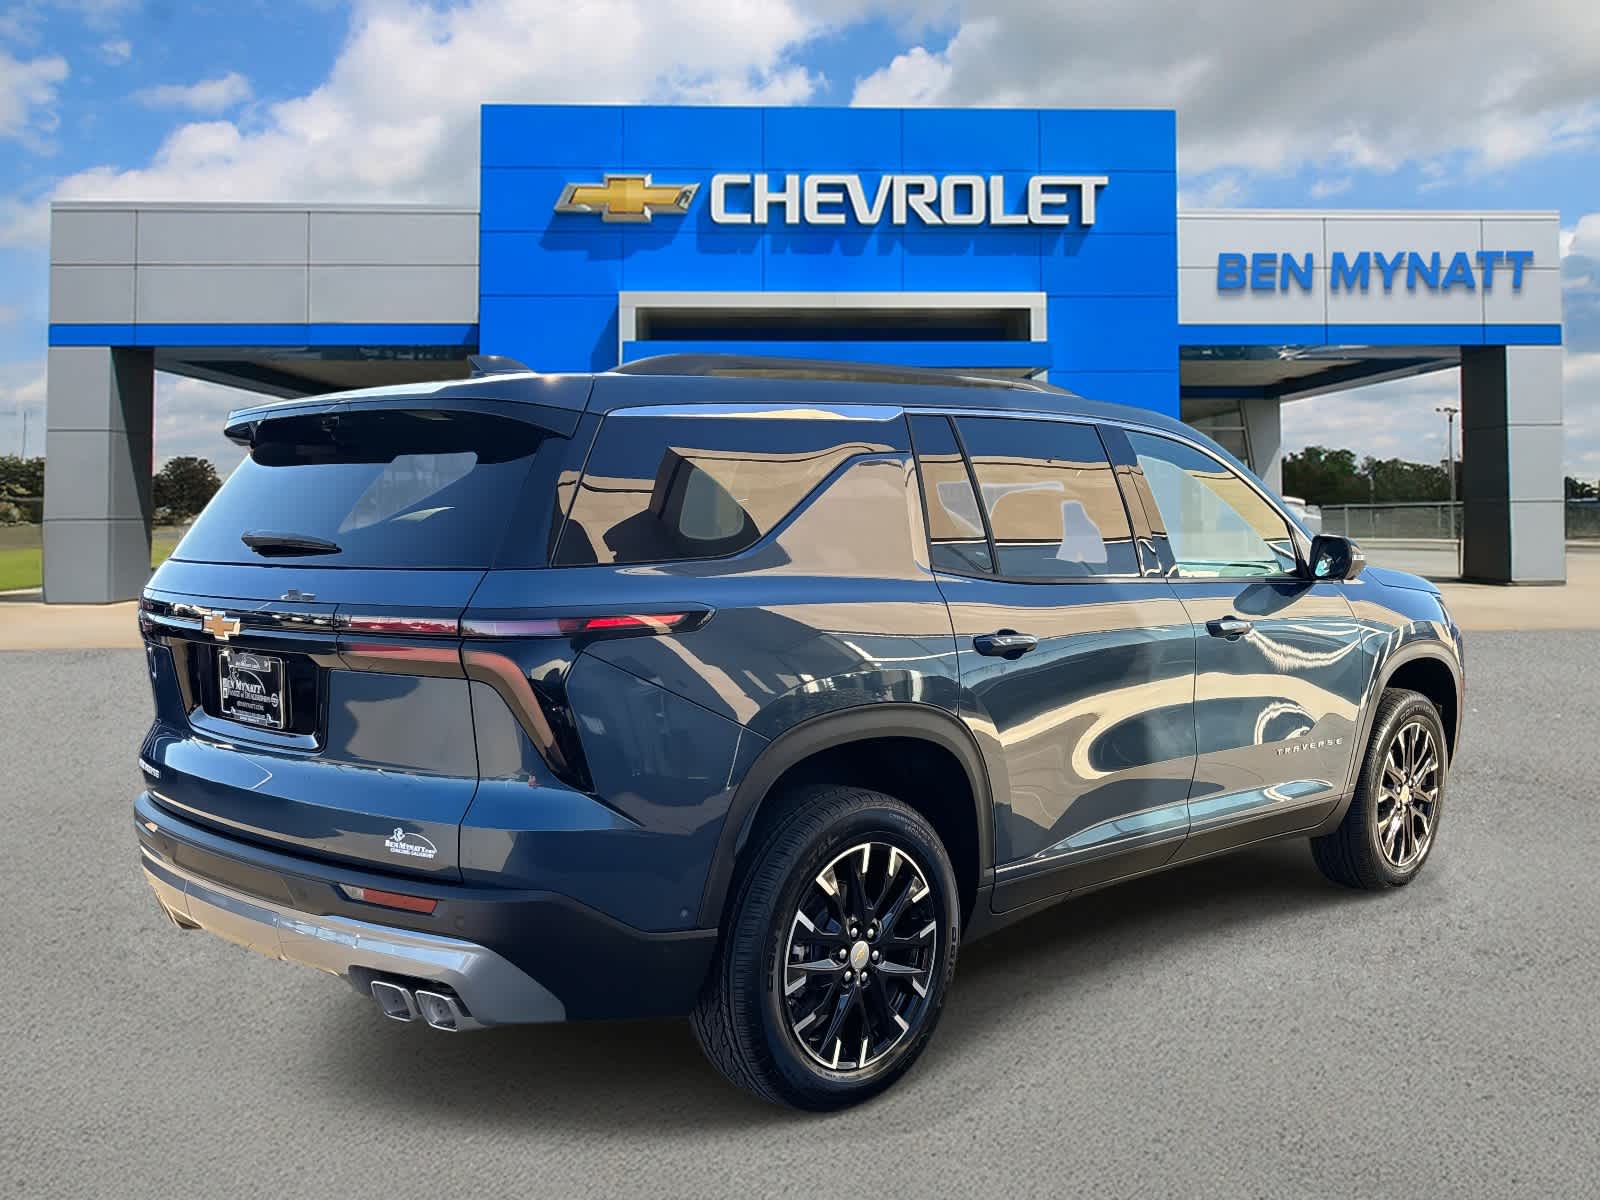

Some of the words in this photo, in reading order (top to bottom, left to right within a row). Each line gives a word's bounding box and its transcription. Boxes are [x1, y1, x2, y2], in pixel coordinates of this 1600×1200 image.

[709, 173, 1109, 226] CHEVROLET
[1216, 252, 1314, 291] BEN
[1330, 250, 1534, 290] MYNATT
[235, 680, 262, 694] MYNATT
[1277, 737, 1344, 756] TRAVERSE
